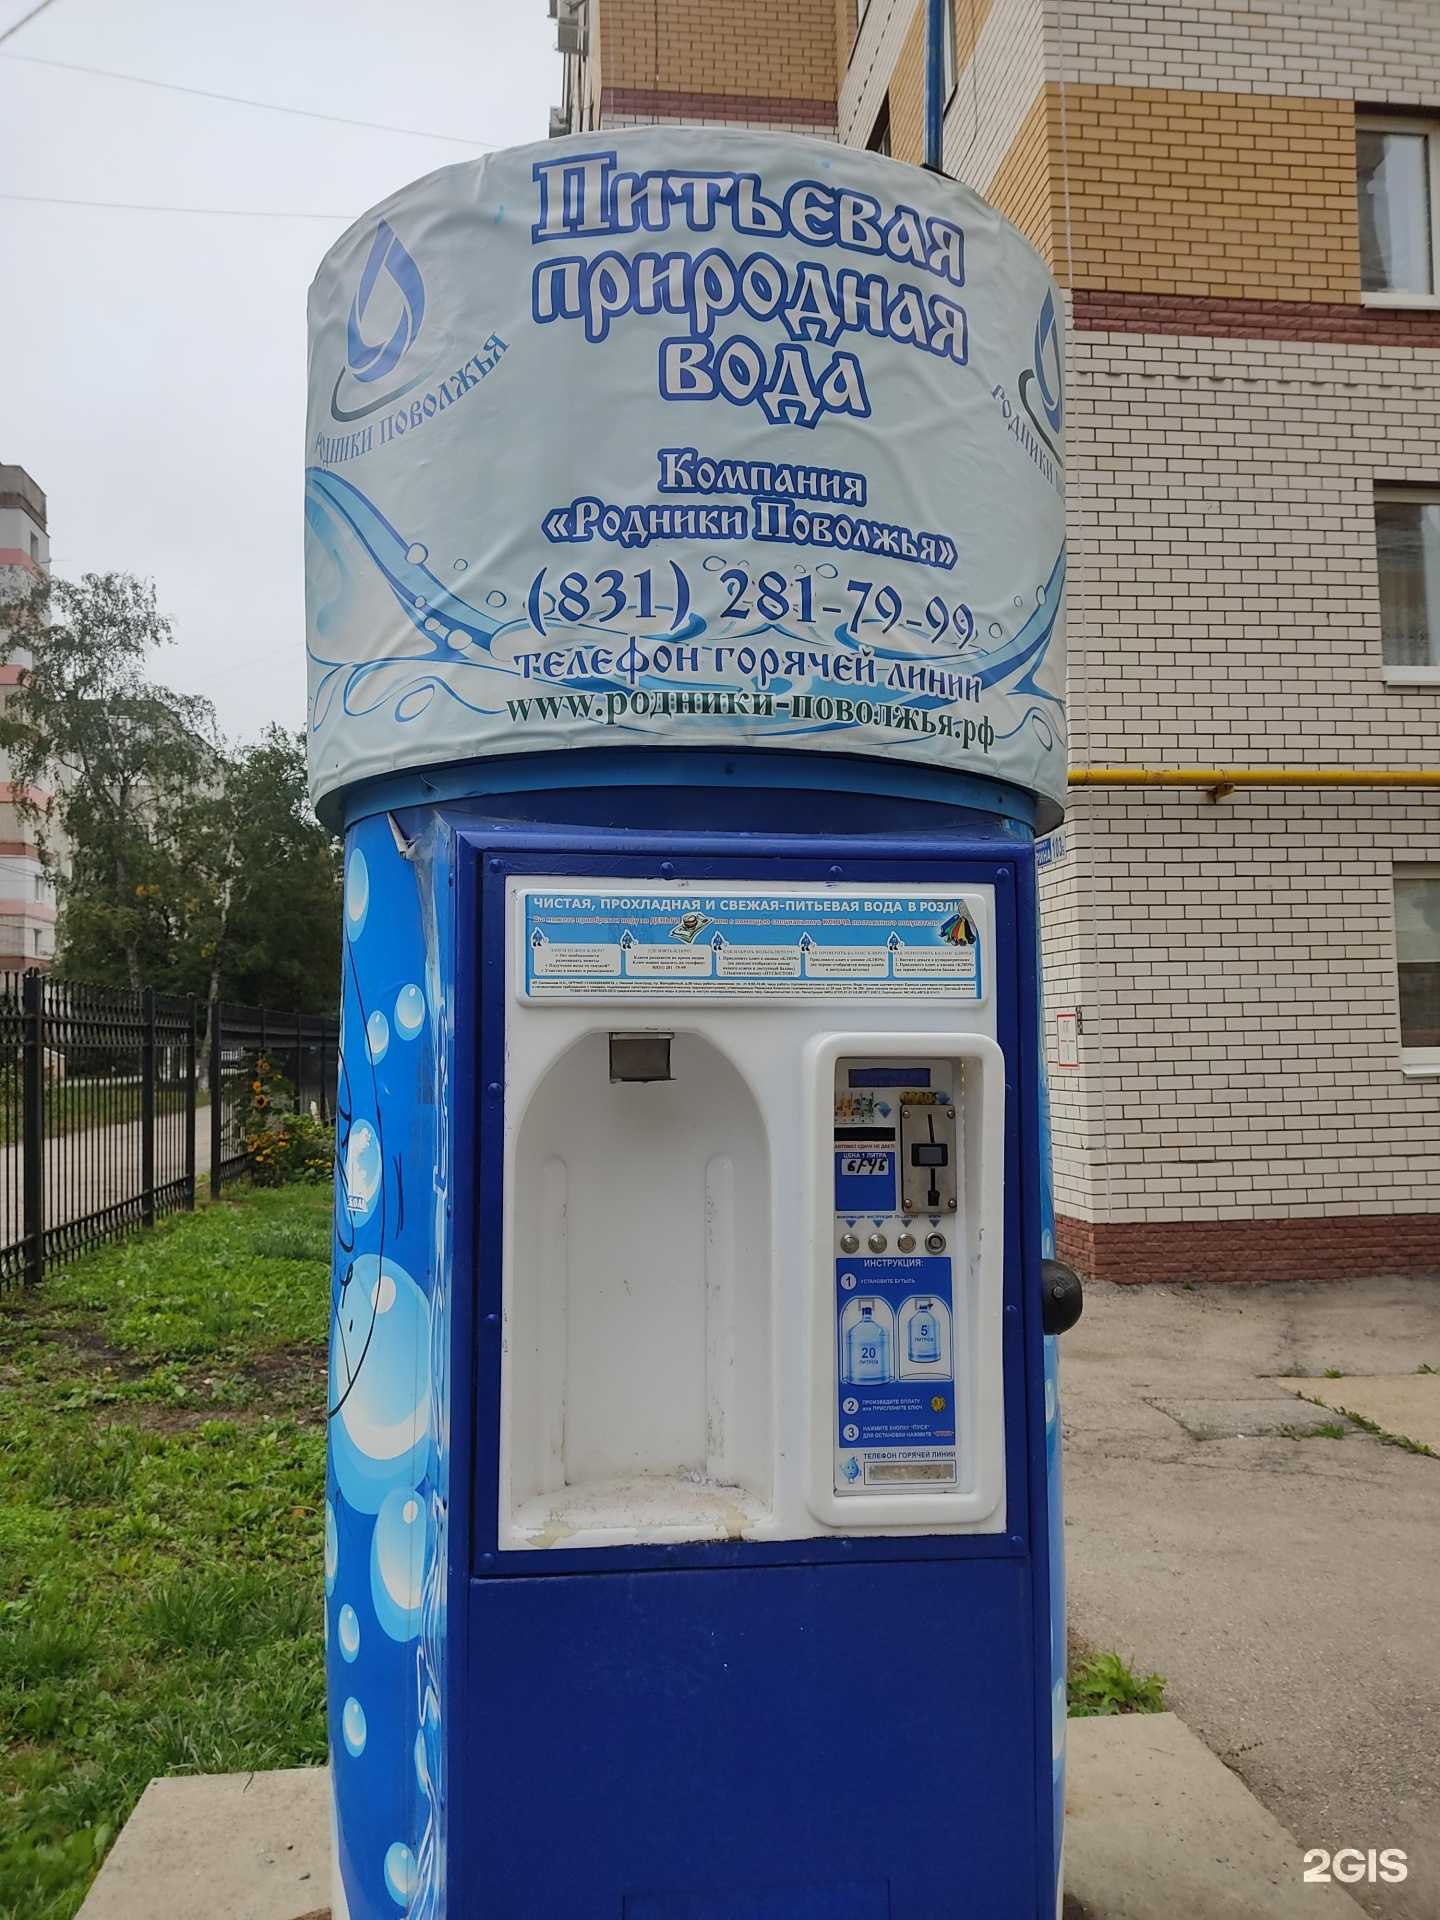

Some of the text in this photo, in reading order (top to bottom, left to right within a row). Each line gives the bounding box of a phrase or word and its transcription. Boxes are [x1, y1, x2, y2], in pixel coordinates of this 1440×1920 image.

[532, 150, 965, 287] Питьевая
[532, 248, 968, 366] природная
[379, 331, 511, 445] ПОВОЛЖЬЯ
[659, 335, 871, 429] вода
[658, 447, 867, 507] Компания
[541, 496, 959, 570] «Родники Поволжья»
[527, 560, 975, 649] (831) 281-79-99
[514, 635, 983, 704] телефон горячей линии
[506, 687, 996, 754] www.родники-поволжья.рф
[534, 897, 596, 911] ЧИСТАЯ,
[600, 898, 701, 912] ПРОХЛАДНАЯ
[705, 899, 716, 910] И
[720, 899, 859, 912] СВЕЖАЯ-ПИТЬЕВАЯ
[864, 900, 903, 914] ВОДА
[908, 901, 917, 912] В
[846, 1275, 852, 1287] 1
[863, 1258, 925, 1268] ИНСТРУКЦИЯ:
[861, 1347, 876, 1359] 20
[920, 1324, 929, 1336] 5
[847, 1400, 855, 1412] 2
[847, 1427, 855, 1439] 3
